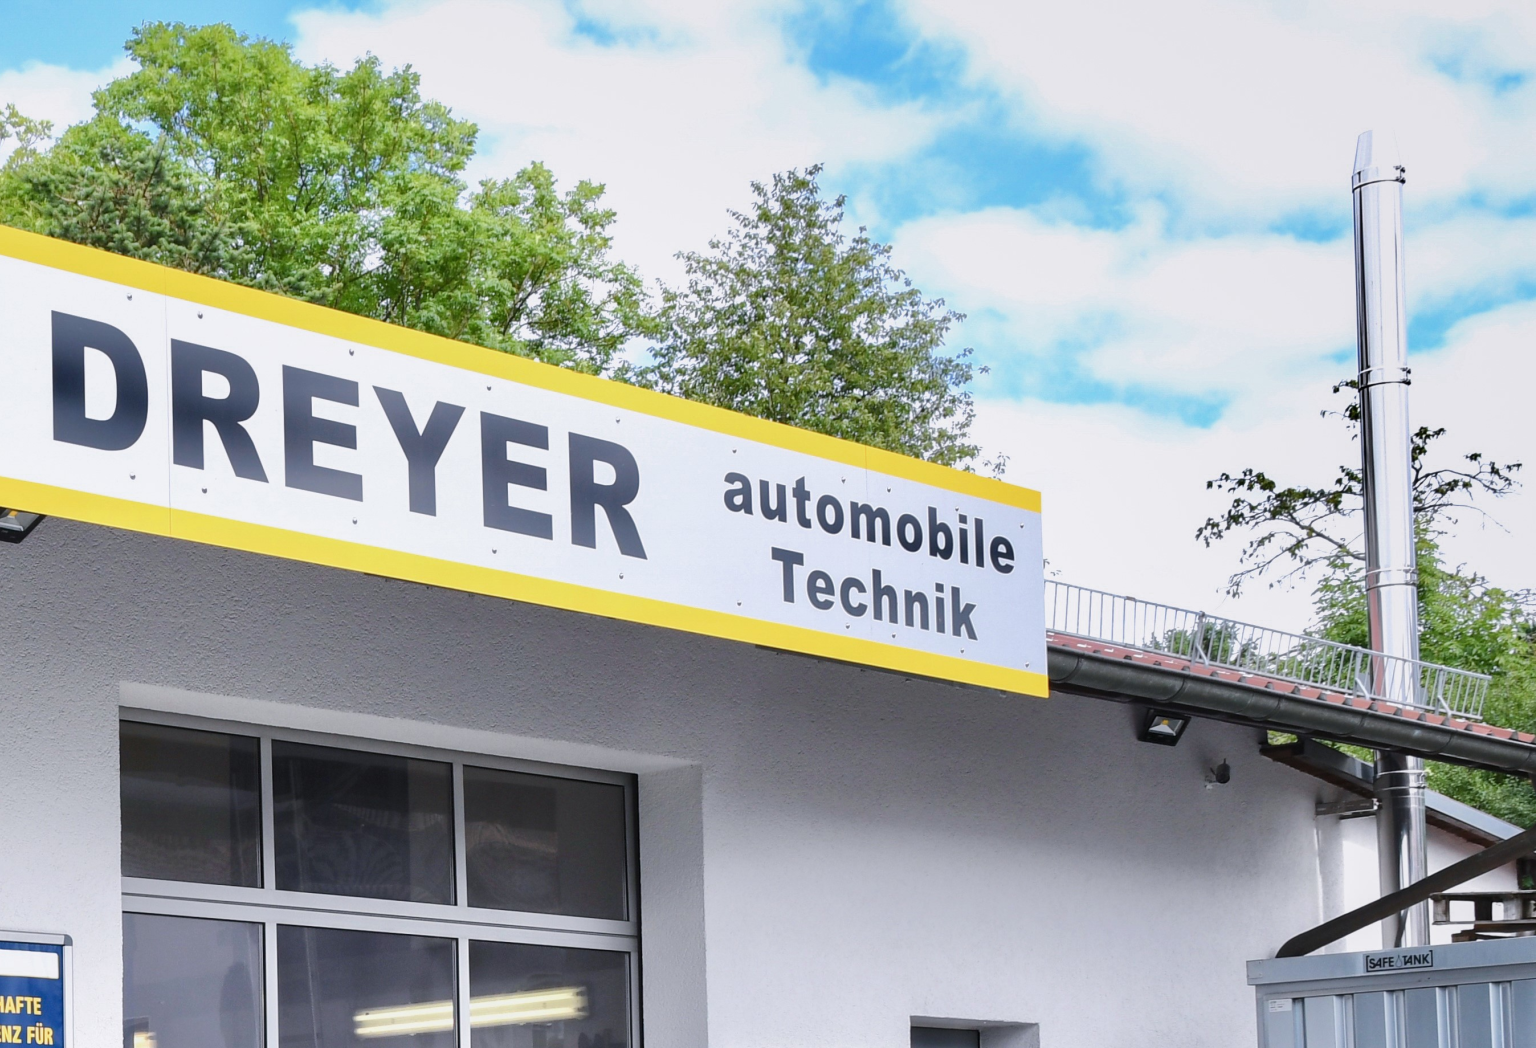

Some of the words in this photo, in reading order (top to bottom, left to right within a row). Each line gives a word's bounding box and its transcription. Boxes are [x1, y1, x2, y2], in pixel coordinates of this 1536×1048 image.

[50, 309, 648, 560] DREYER
[722, 470, 1016, 574] automobile
[768, 546, 978, 641] Technik
[1368, 956, 1394, 969] SAFE
[1402, 953, 1430, 966] TANK
[26, 1022, 54, 1045] FÜR
